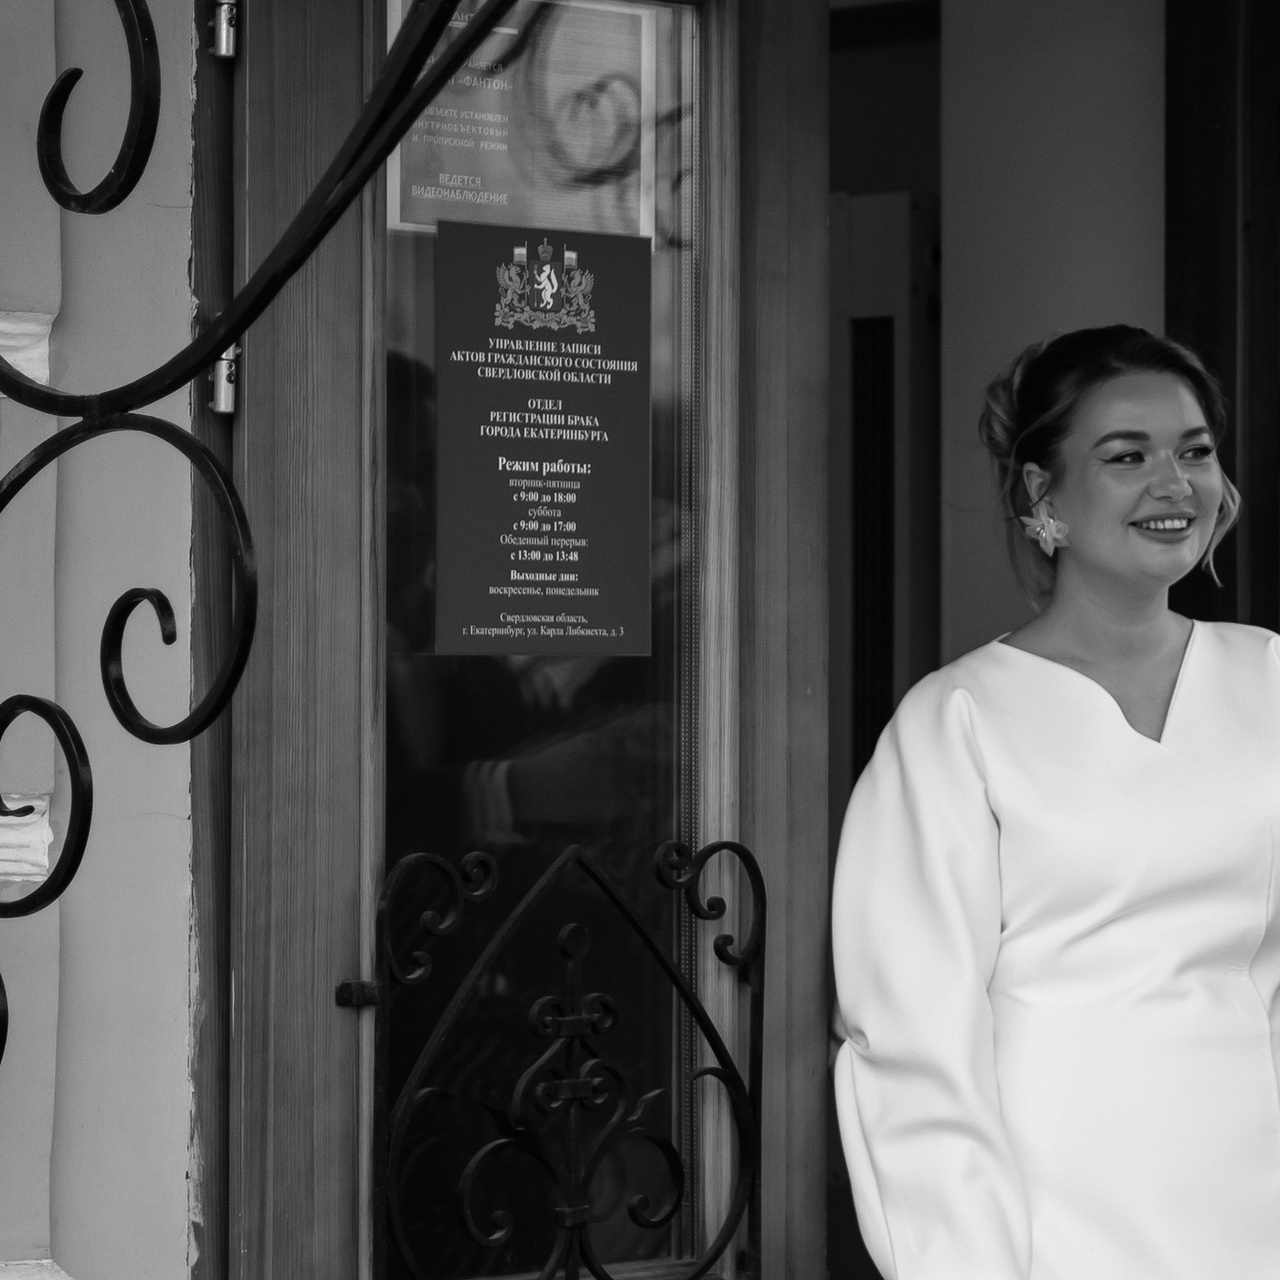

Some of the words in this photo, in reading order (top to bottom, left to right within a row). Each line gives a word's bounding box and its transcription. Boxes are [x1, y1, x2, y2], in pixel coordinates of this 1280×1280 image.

[460, 110, 508, 122] УСТАНОВЛЕН
[423, 136, 474, 147] ПРОПУСКНОЙ
[480, 141, 508, 150] РЕЖИМ
[439, 173, 482, 186] ВЕДЕТСЯ
[412, 185, 508, 204] ВИДЕОНАБЛЮДЕНИЕ
[489, 338, 557, 353] УПРАВЛЕНИЕ
[560, 342, 601, 354] ЗАПИСИ
[450, 351, 485, 362] АКТОВ
[487, 353, 572, 367] ГРАЖДАНСКОГО
[575, 358, 638, 371] СОСТОЯНИЯ
[478, 367, 560, 382] СВЕРДЛОВСКОЙ
[563, 372, 611, 384] ОБЛАСТИ
[528, 399, 562, 411] ОТДЕЛ
[490, 411, 564, 426] РЕГИСТРАЦИИ
[567, 415, 599, 426] БРАКА
[480, 426, 521, 438] ГОРОДА
[524, 428, 609, 442] ЕКАТЕРИНБУРГА
[498, 456, 539, 472] Режим
[542, 460, 592, 475] работы:
[509, 478, 580, 489] вторник-пятница
[520, 491, 539, 501] 9:00
[541, 494, 551, 503] до
[554, 493, 576, 503] 18:00
[528, 506, 561, 518] суббота
[520, 520, 539, 530] 9:00
[541, 523, 551, 532] до
[554, 522, 576, 532] 17:00
[500, 534, 548, 546] Обеденный
[551, 538, 588, 548] перерыв:
[518, 550, 541, 561] 13:00
[543, 553, 554, 562] до
[556, 551, 579, 561] 13:48
[510, 570, 557, 581] Выходные
[559, 573, 579, 582] дни:
[489, 586, 543, 596] воскресенье,
[546, 587, 599, 596] понедельник
[500, 613, 554, 624] Свердловская
[556, 613, 588, 624] область,
[470, 625, 525, 637] Екатеринбург,
[527, 628, 538, 637] ул.
[541, 626, 563, 636] Карла
[566, 627, 608, 637] Либкнехта,
[610, 629, 618, 637] д.
[620, 627, 624, 636] 3
